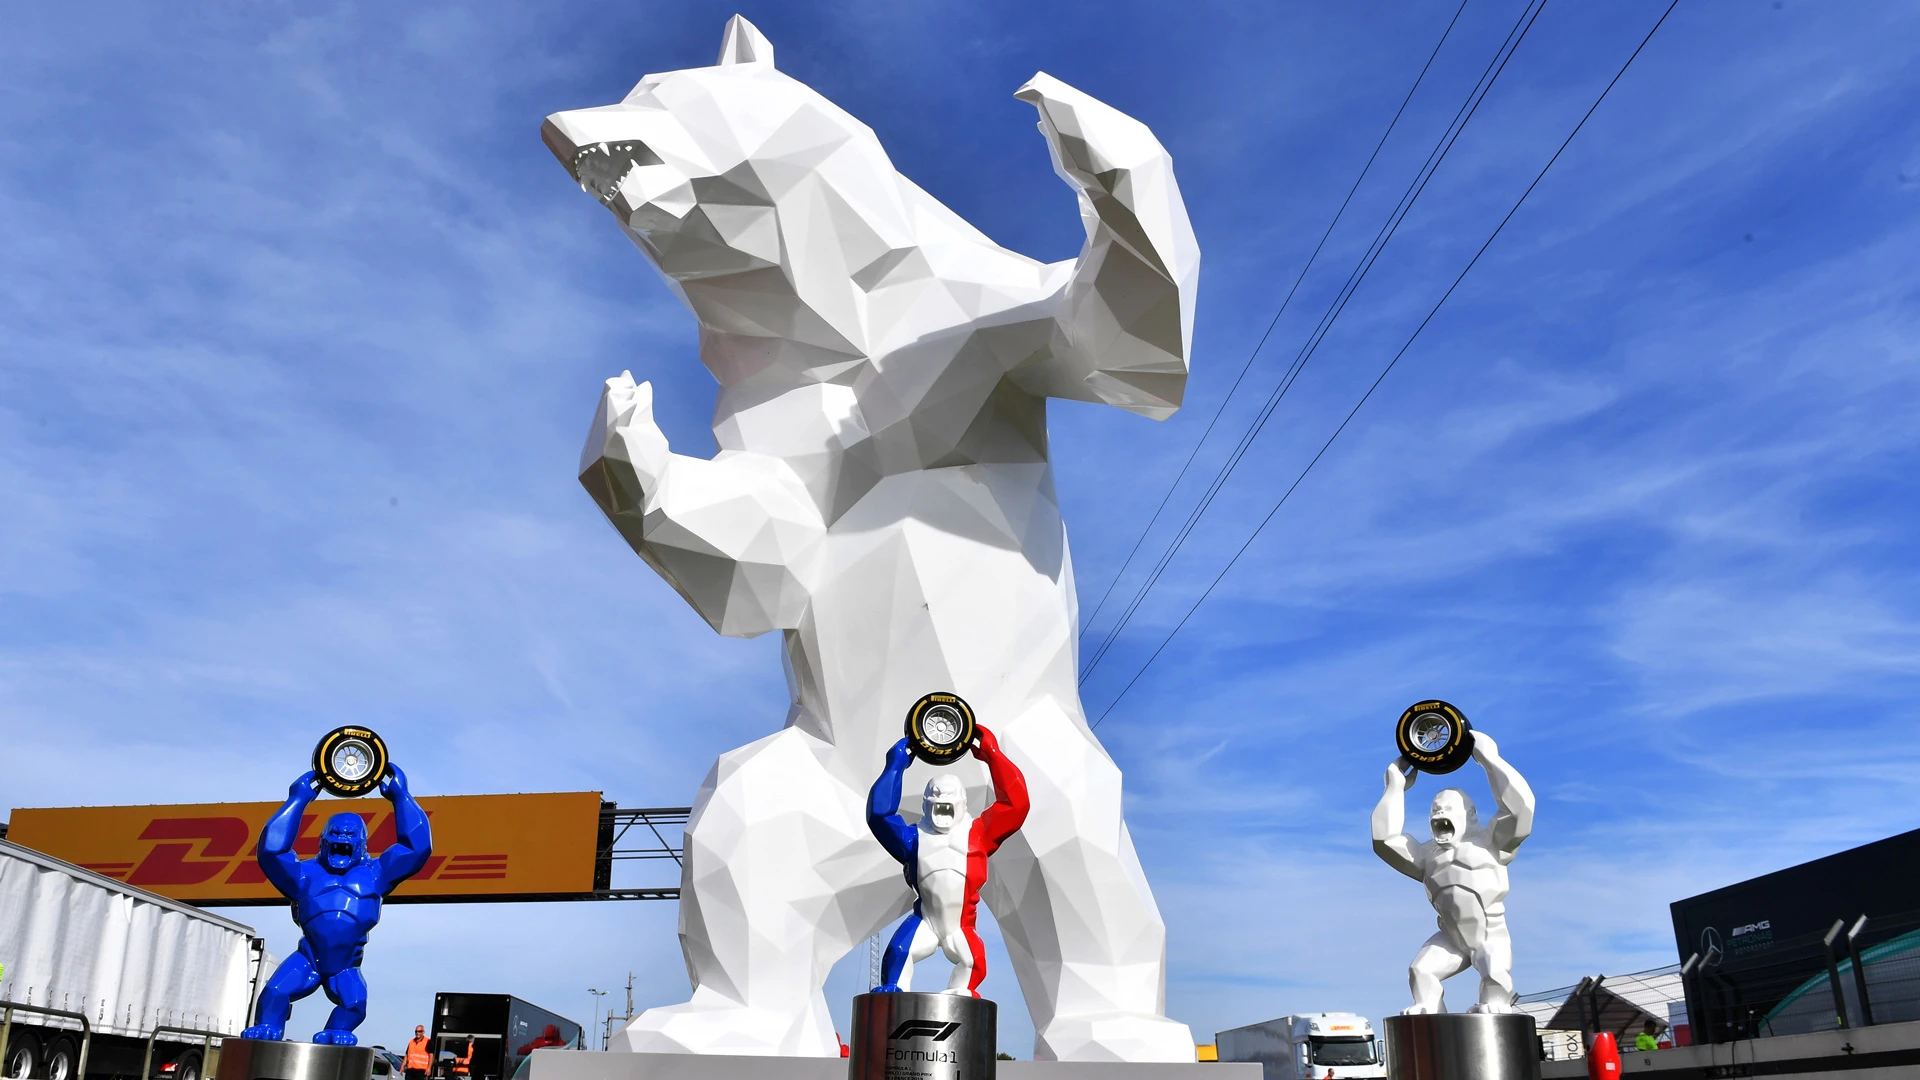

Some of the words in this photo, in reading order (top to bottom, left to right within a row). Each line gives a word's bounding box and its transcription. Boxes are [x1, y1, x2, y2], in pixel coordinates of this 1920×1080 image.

[1414, 702, 1440, 711] PIRELLI
[344, 728, 371, 738] PIRELLI
[920, 742, 952, 754] ZERO
[1410, 752, 1445, 762] ZERO
[326, 775, 361, 791] ZERO
[1741, 920, 1771, 934] AMG
